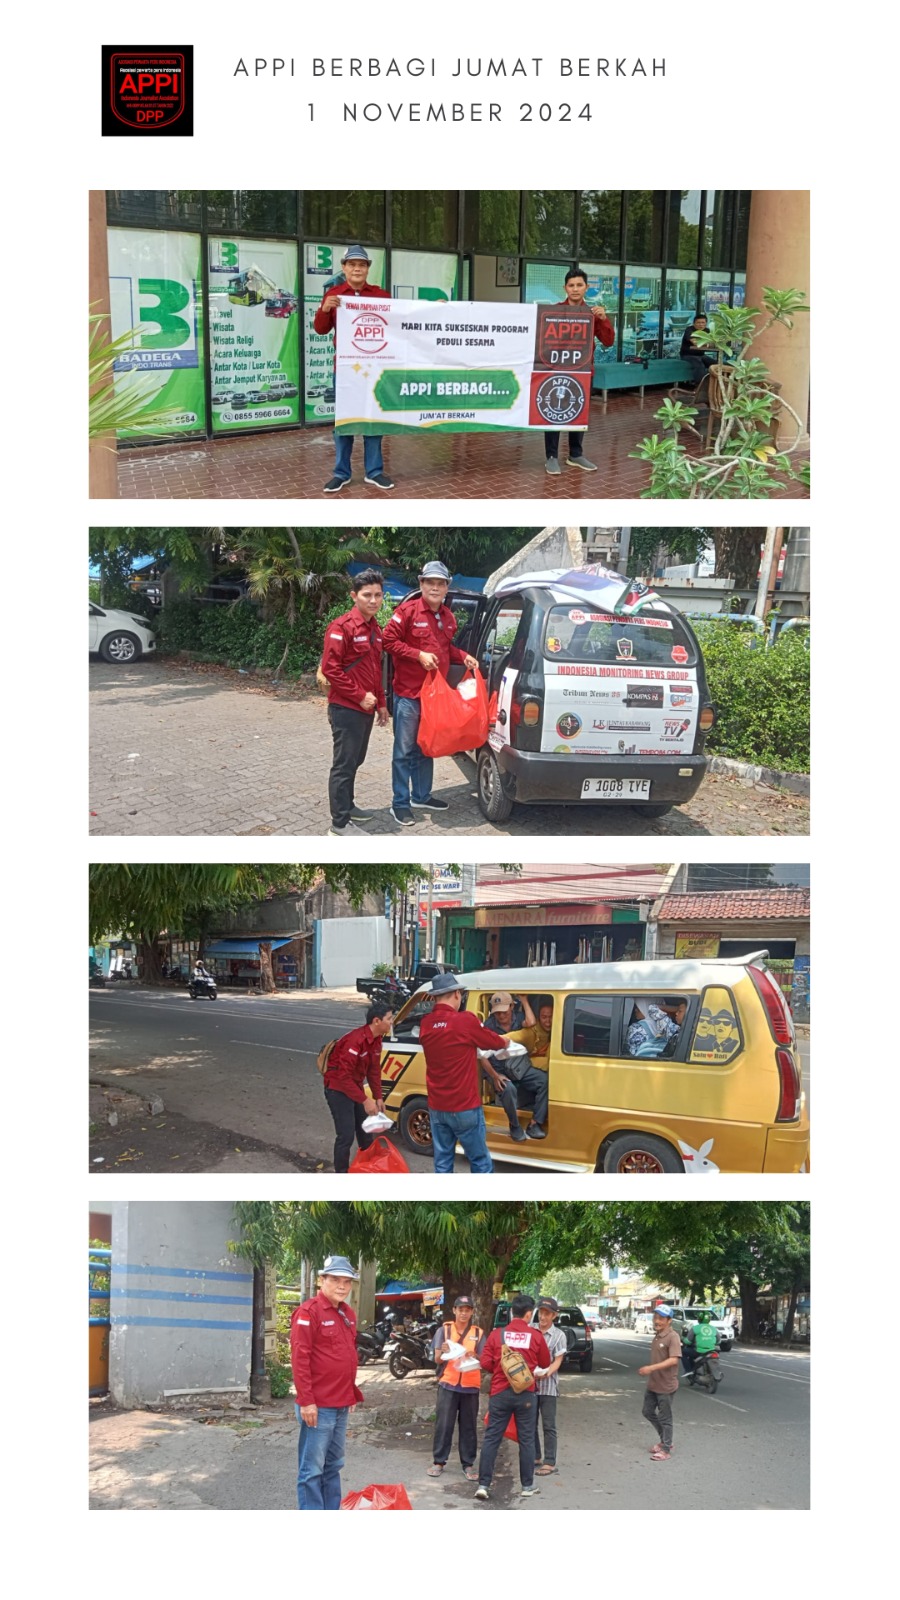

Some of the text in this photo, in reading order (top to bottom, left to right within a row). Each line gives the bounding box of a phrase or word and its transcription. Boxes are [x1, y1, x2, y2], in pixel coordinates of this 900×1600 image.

[213, 323, 235, 332] Wisata
[354, 327, 384, 338] APPI
[401, 322, 529, 334] MARI KITA SUKSESKAN PROGRAM
[544, 322, 588, 339] APPI
[213, 335, 254, 347] Wisata Religi
[436, 338, 496, 347] PEDULI SESAMA
[120, 352, 182, 363] BADEGA
[214, 349, 233, 359] Acara
[214, 363, 232, 372] Antar
[233, 362, 248, 371] Kota
[252, 361, 266, 370] Luar
[267, 361, 281, 369] Kota
[215, 376, 232, 385] Antar
[233, 375, 256, 385] Jemput
[552, 379, 571, 387] APPI
[400, 382, 432, 396] APPI
[235, 413, 253, 421] 0855
[419, 413, 446, 421] JUM'AT
[543, 407, 578, 421] PODCAST
[557, 666, 689, 681] INDONESIA MONITORING NEWS GROUP
[590, 690, 610, 698] News
[664, 727, 678, 736] TV
[584, 780, 649, 793] B 1008 TYE
[547, 911, 610, 926] furniture
[383, 1057, 404, 1080] 17
